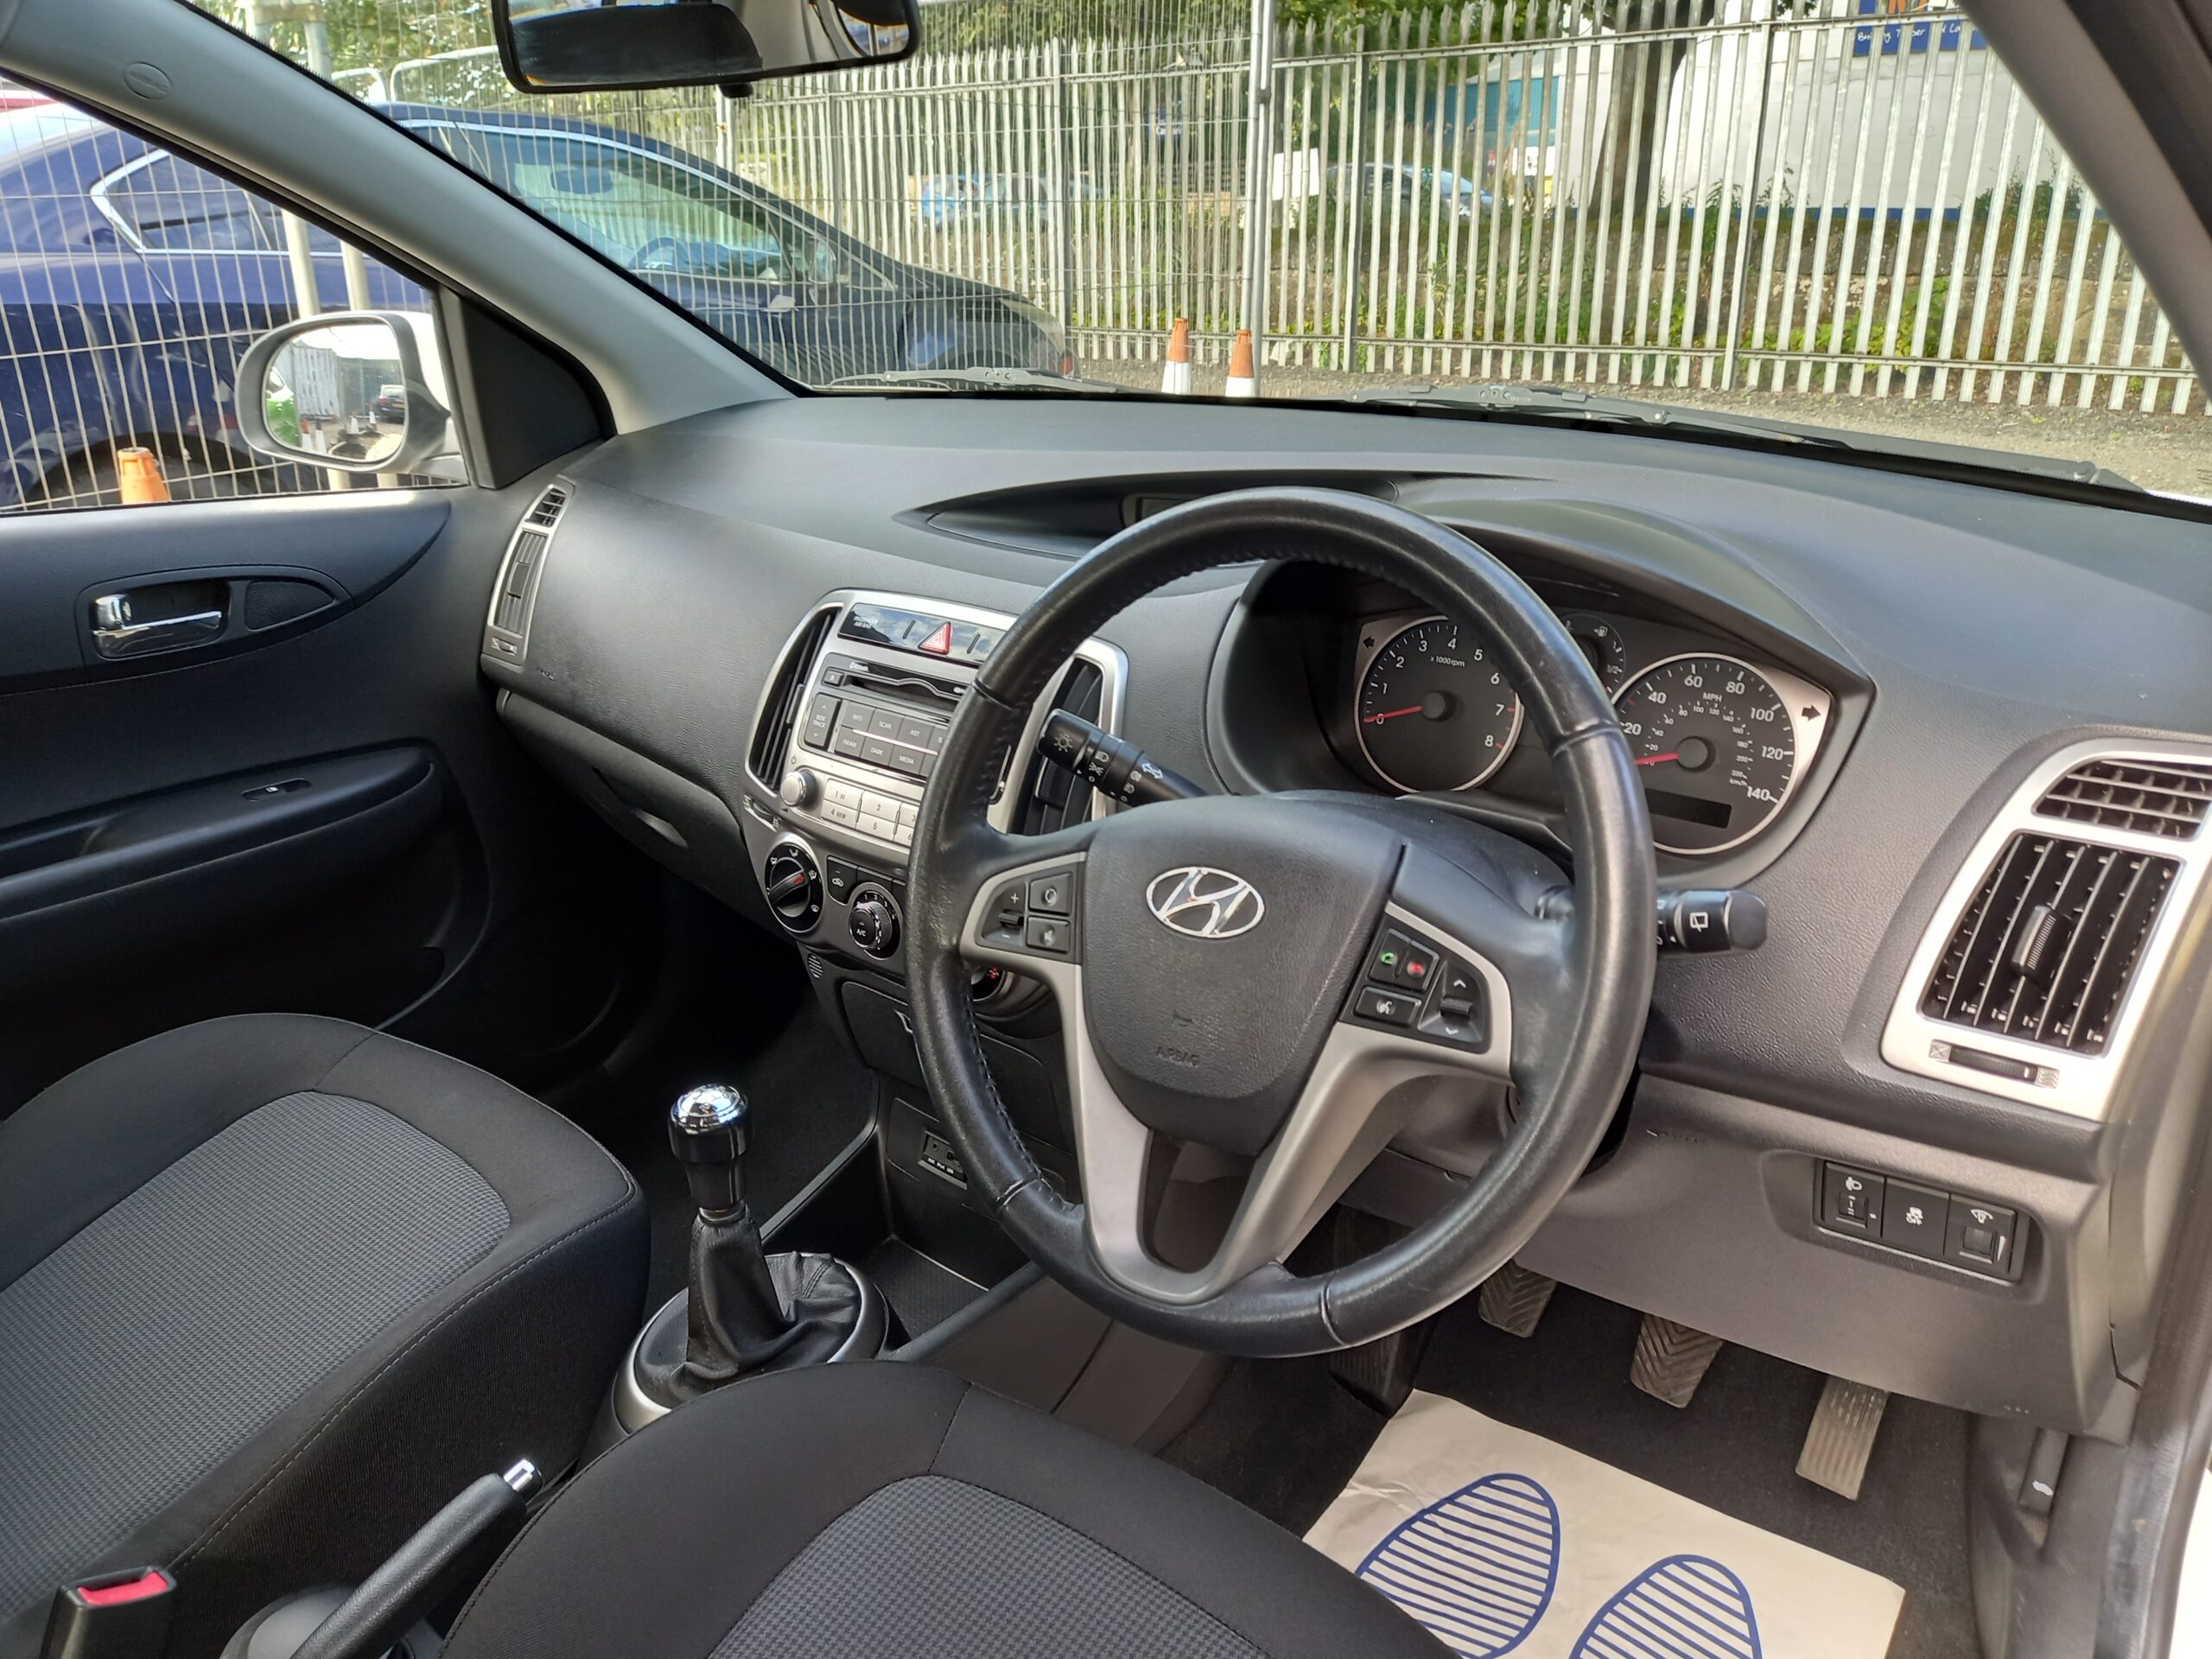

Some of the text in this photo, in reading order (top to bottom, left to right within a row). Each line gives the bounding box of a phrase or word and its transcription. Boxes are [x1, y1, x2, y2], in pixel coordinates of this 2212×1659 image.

[1418, 640, 1427, 652] 3
[1447, 638, 1457, 649] 4
[1474, 649, 1484, 661] 5
[1395, 656, 1405, 668] 2
[1491, 672, 1500, 684] 6
[1684, 676, 1704, 688] 60
[1382, 683, 1388, 694] 1
[1726, 681, 1745, 695] 80
[1648, 691, 1667, 704] 40
[1702, 692, 1723, 702] MPH
[1496, 703, 1504, 715] 7
[1751, 707, 1774, 721] 100
[813, 719, 826, 728] TRACK
[878, 720, 893, 730] SCAN
[1623, 721, 1642, 735] 20
[1484, 734, 1494, 747] 8
[870, 747, 883, 756] DARK
[1762, 745, 1784, 760] 120
[899, 753, 914, 766] MEDIA
[1747, 785, 1771, 801] 140
[876, 804, 881, 812] 2
[873, 822, 878, 830] 5
[856, 928, 867, 937] A/C
